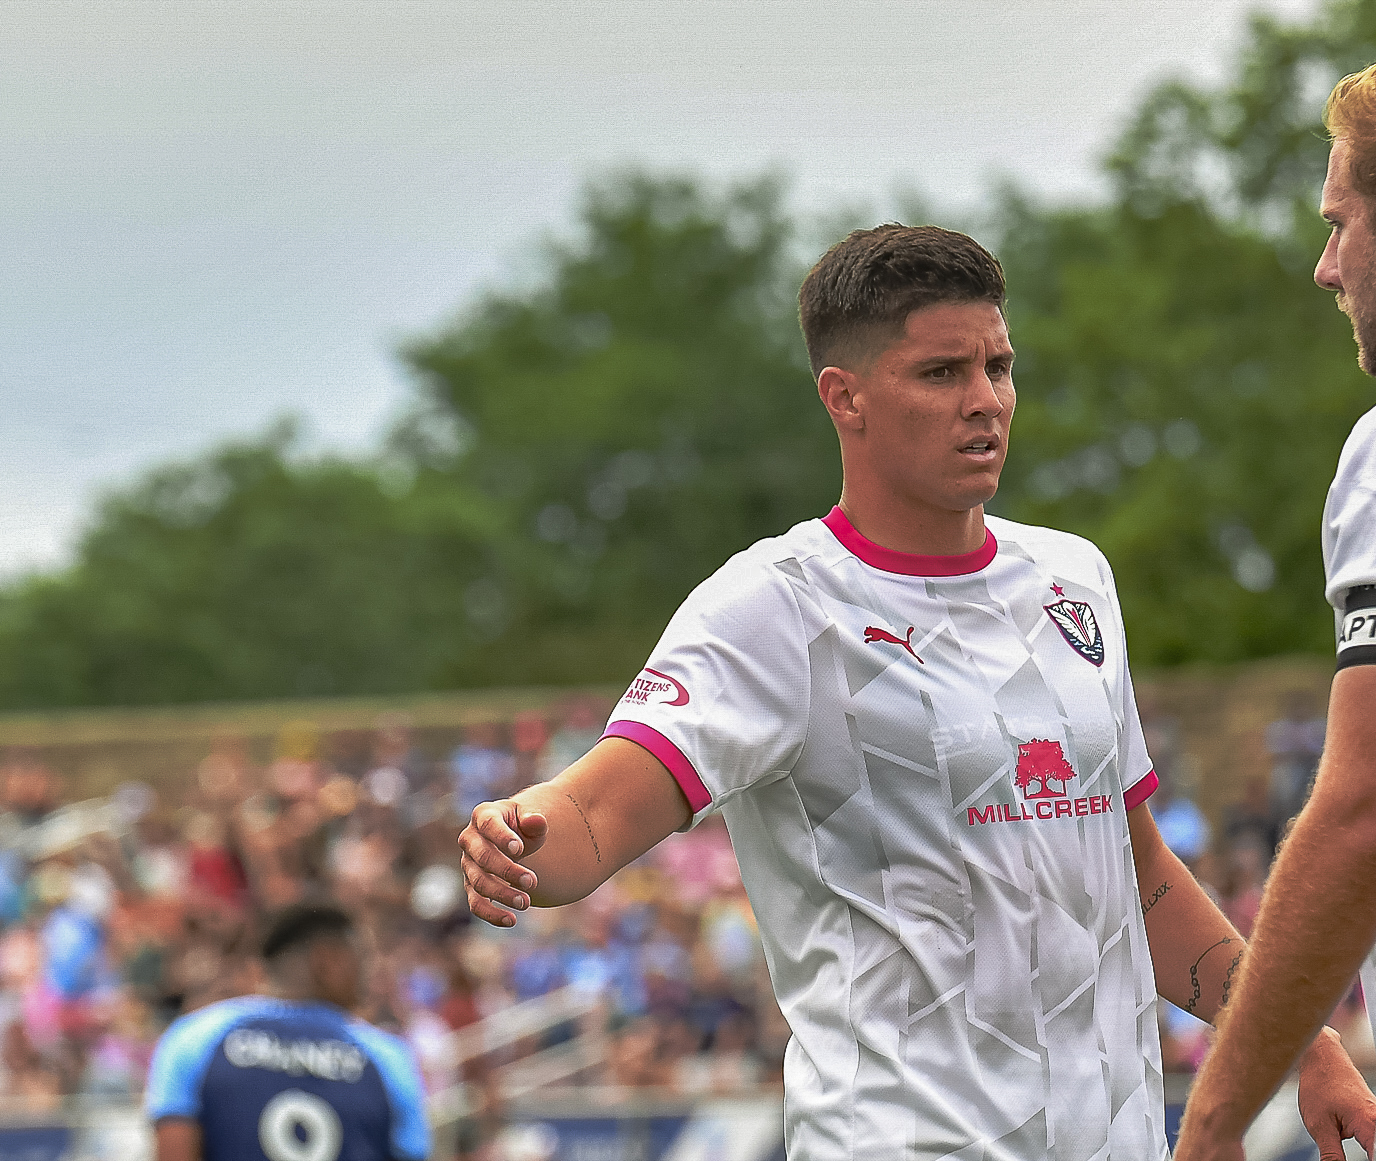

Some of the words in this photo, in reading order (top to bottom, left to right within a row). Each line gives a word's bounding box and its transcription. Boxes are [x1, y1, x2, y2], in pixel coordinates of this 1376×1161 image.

[633, 678, 672, 693] TIZENS
[625, 688, 651, 702] ANK
[967, 794, 1114, 826] MILLCREEK
